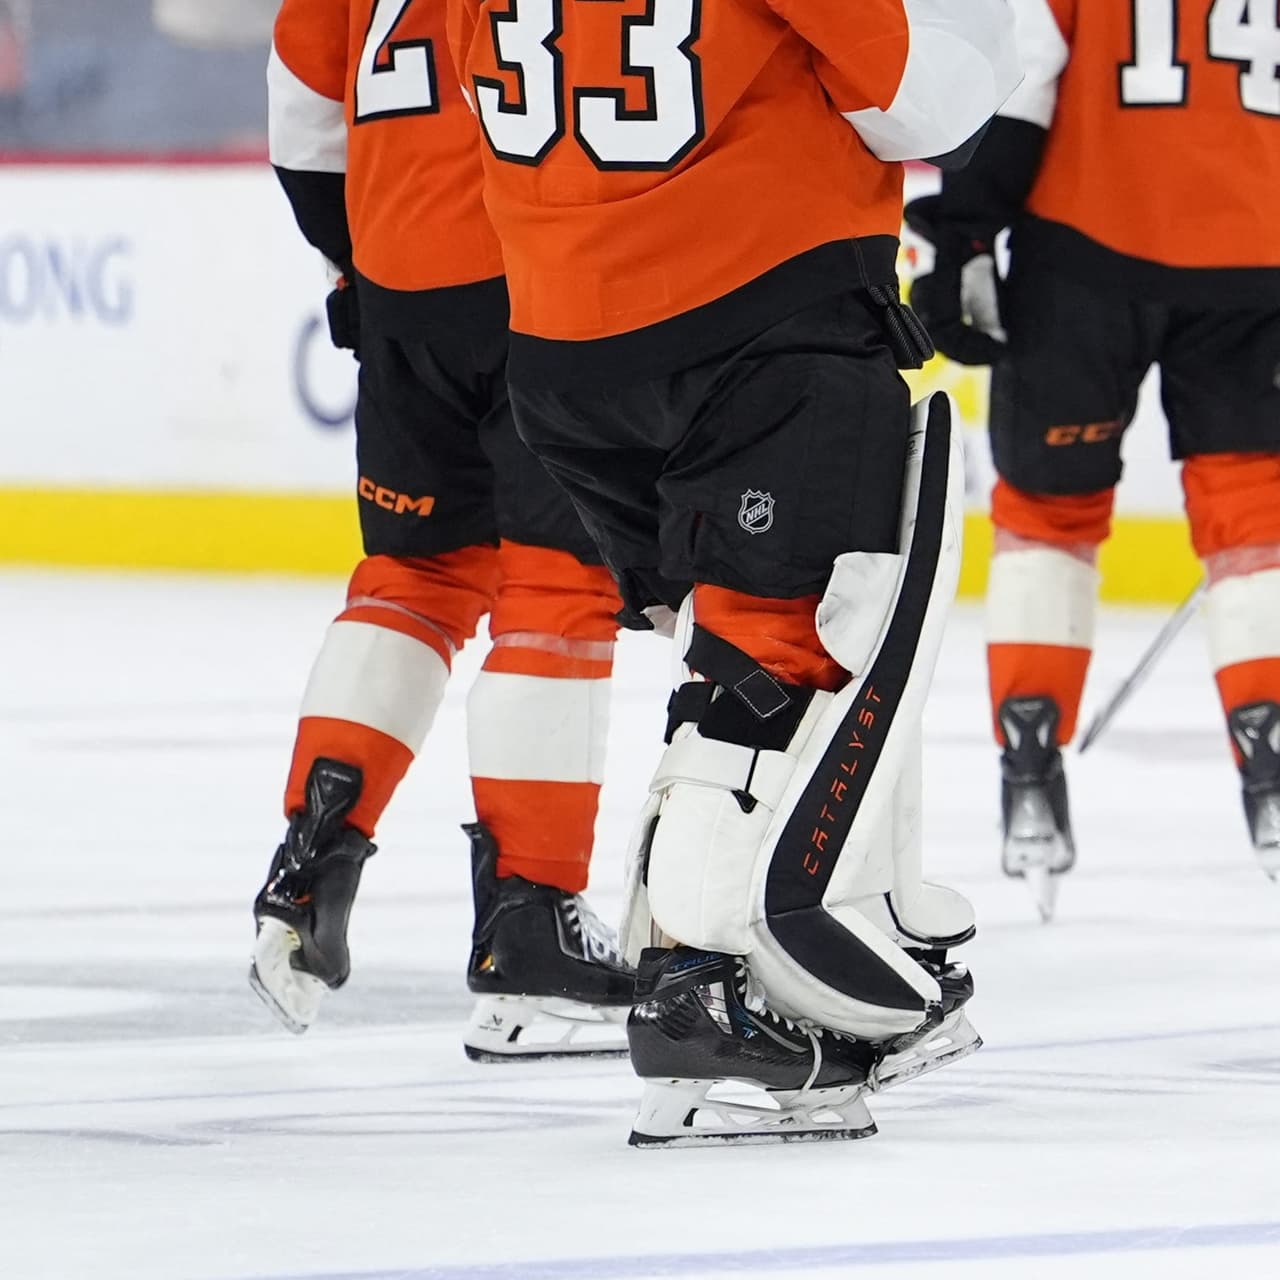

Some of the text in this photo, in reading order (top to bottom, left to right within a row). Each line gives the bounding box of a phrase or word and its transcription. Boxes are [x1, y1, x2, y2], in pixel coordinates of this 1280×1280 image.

[1045, 418, 1123, 447] CC
[359, 476, 435, 517] CCM
[745, 503, 769, 524] NHL
[803, 685, 882, 877] CATALYST
